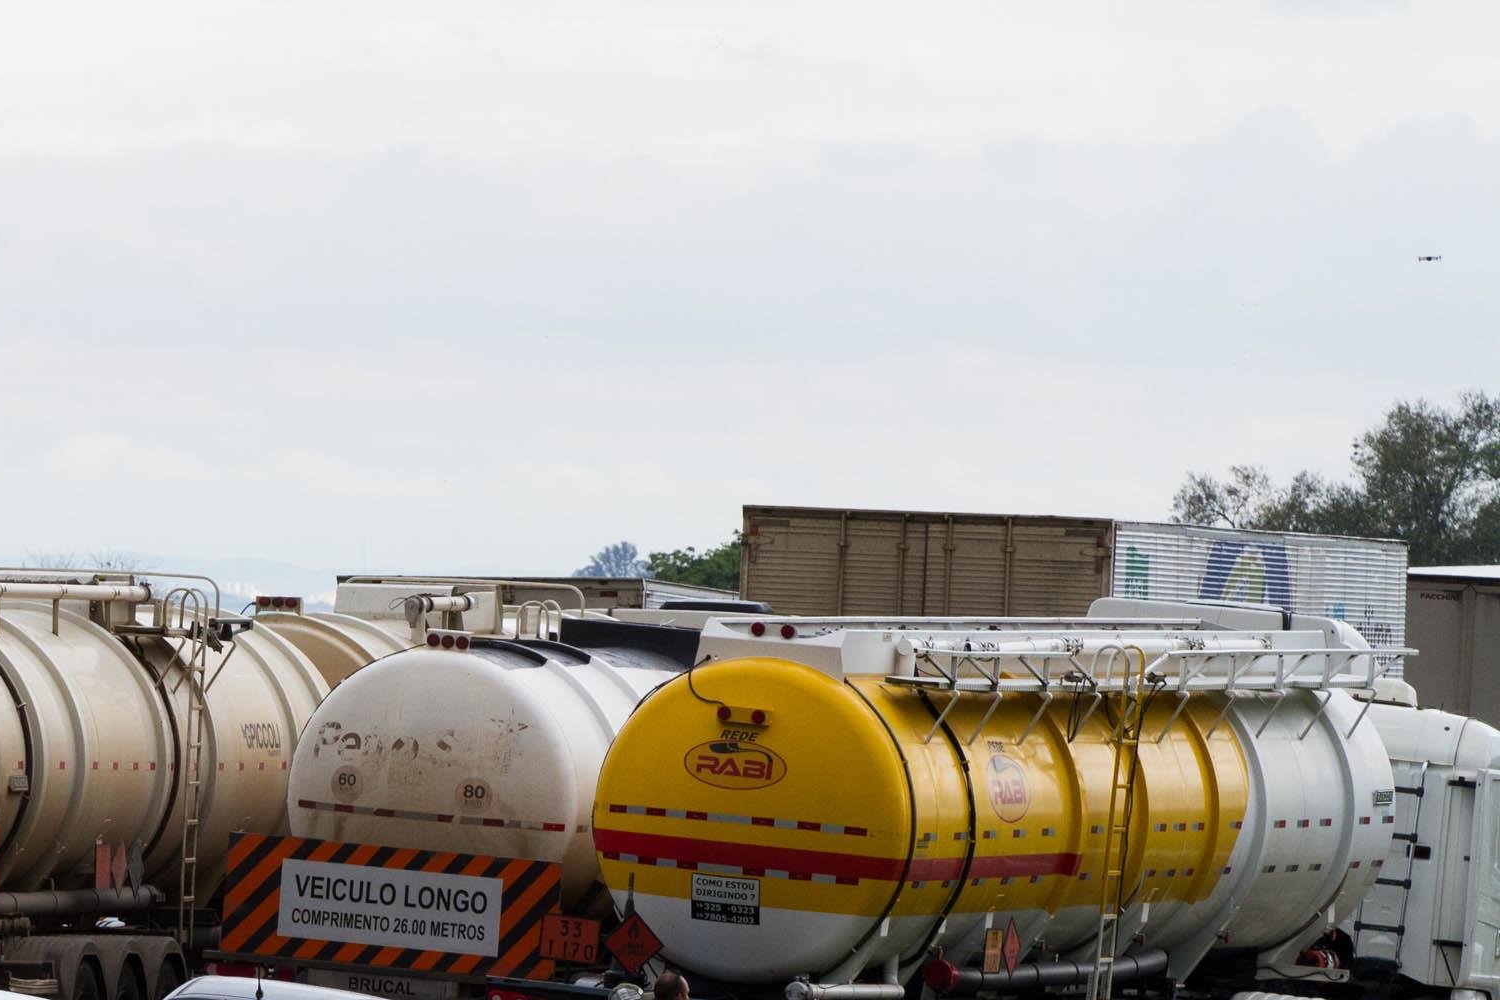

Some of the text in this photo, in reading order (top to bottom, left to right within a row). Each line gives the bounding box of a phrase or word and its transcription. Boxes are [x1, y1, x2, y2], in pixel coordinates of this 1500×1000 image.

[720, 729, 759, 742] REDE
[696, 755, 773, 781] RABI
[338, 772, 357, 787] 60
[463, 784, 486, 800] 80
[696, 877, 755, 891] COMO ESTOU
[295, 874, 488, 914] VEICULO LONGO
[696, 888, 747, 901] DIRIGINDO
[291, 907, 485, 941] COMPRIMENTO 26.00 METROS
[560, 920, 582, 938] 33
[348, 976, 417, 996] BRUCAL
